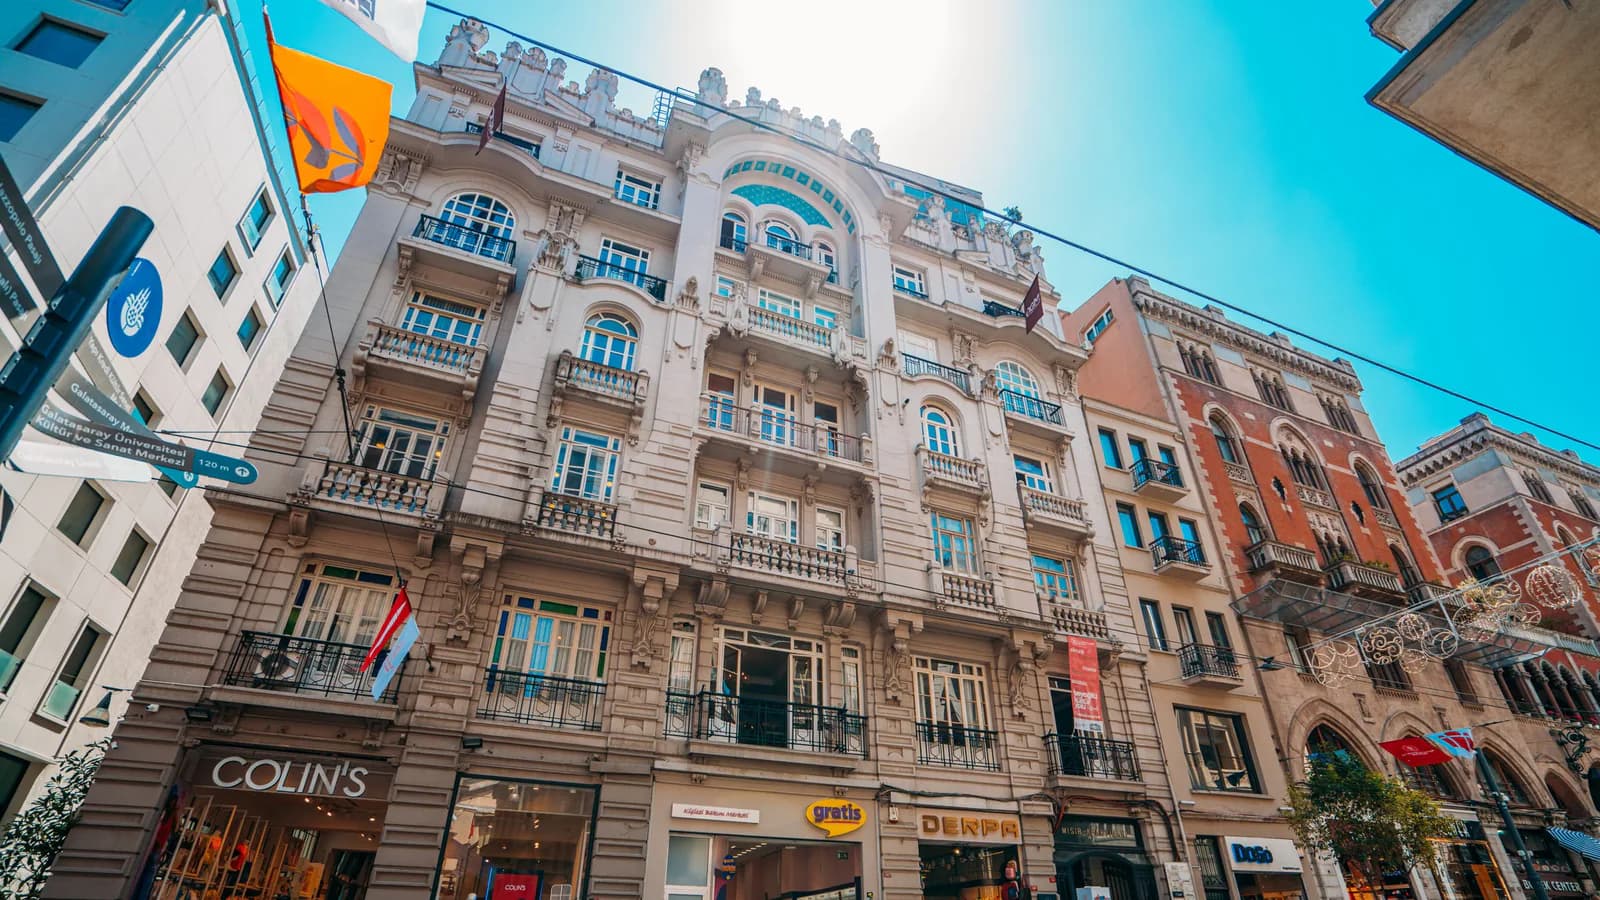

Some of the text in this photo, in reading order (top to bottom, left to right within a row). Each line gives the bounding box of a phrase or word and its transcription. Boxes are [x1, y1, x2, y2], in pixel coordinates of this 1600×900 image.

[70, 382, 122, 427] Galatasaray
[36, 415, 186, 467] Kültür ve Sanat Merkezi
[40, 404, 112, 440] Galatasaray
[114, 430, 188, 458] Üniversitesi
[199, 458, 230, 472] 120 m
[211, 756, 369, 799] COLIN'S
[813, 804, 862, 823] gratis
[922, 814, 1019, 839] DERPA
[1550, 880, 1583, 893] CENTER
